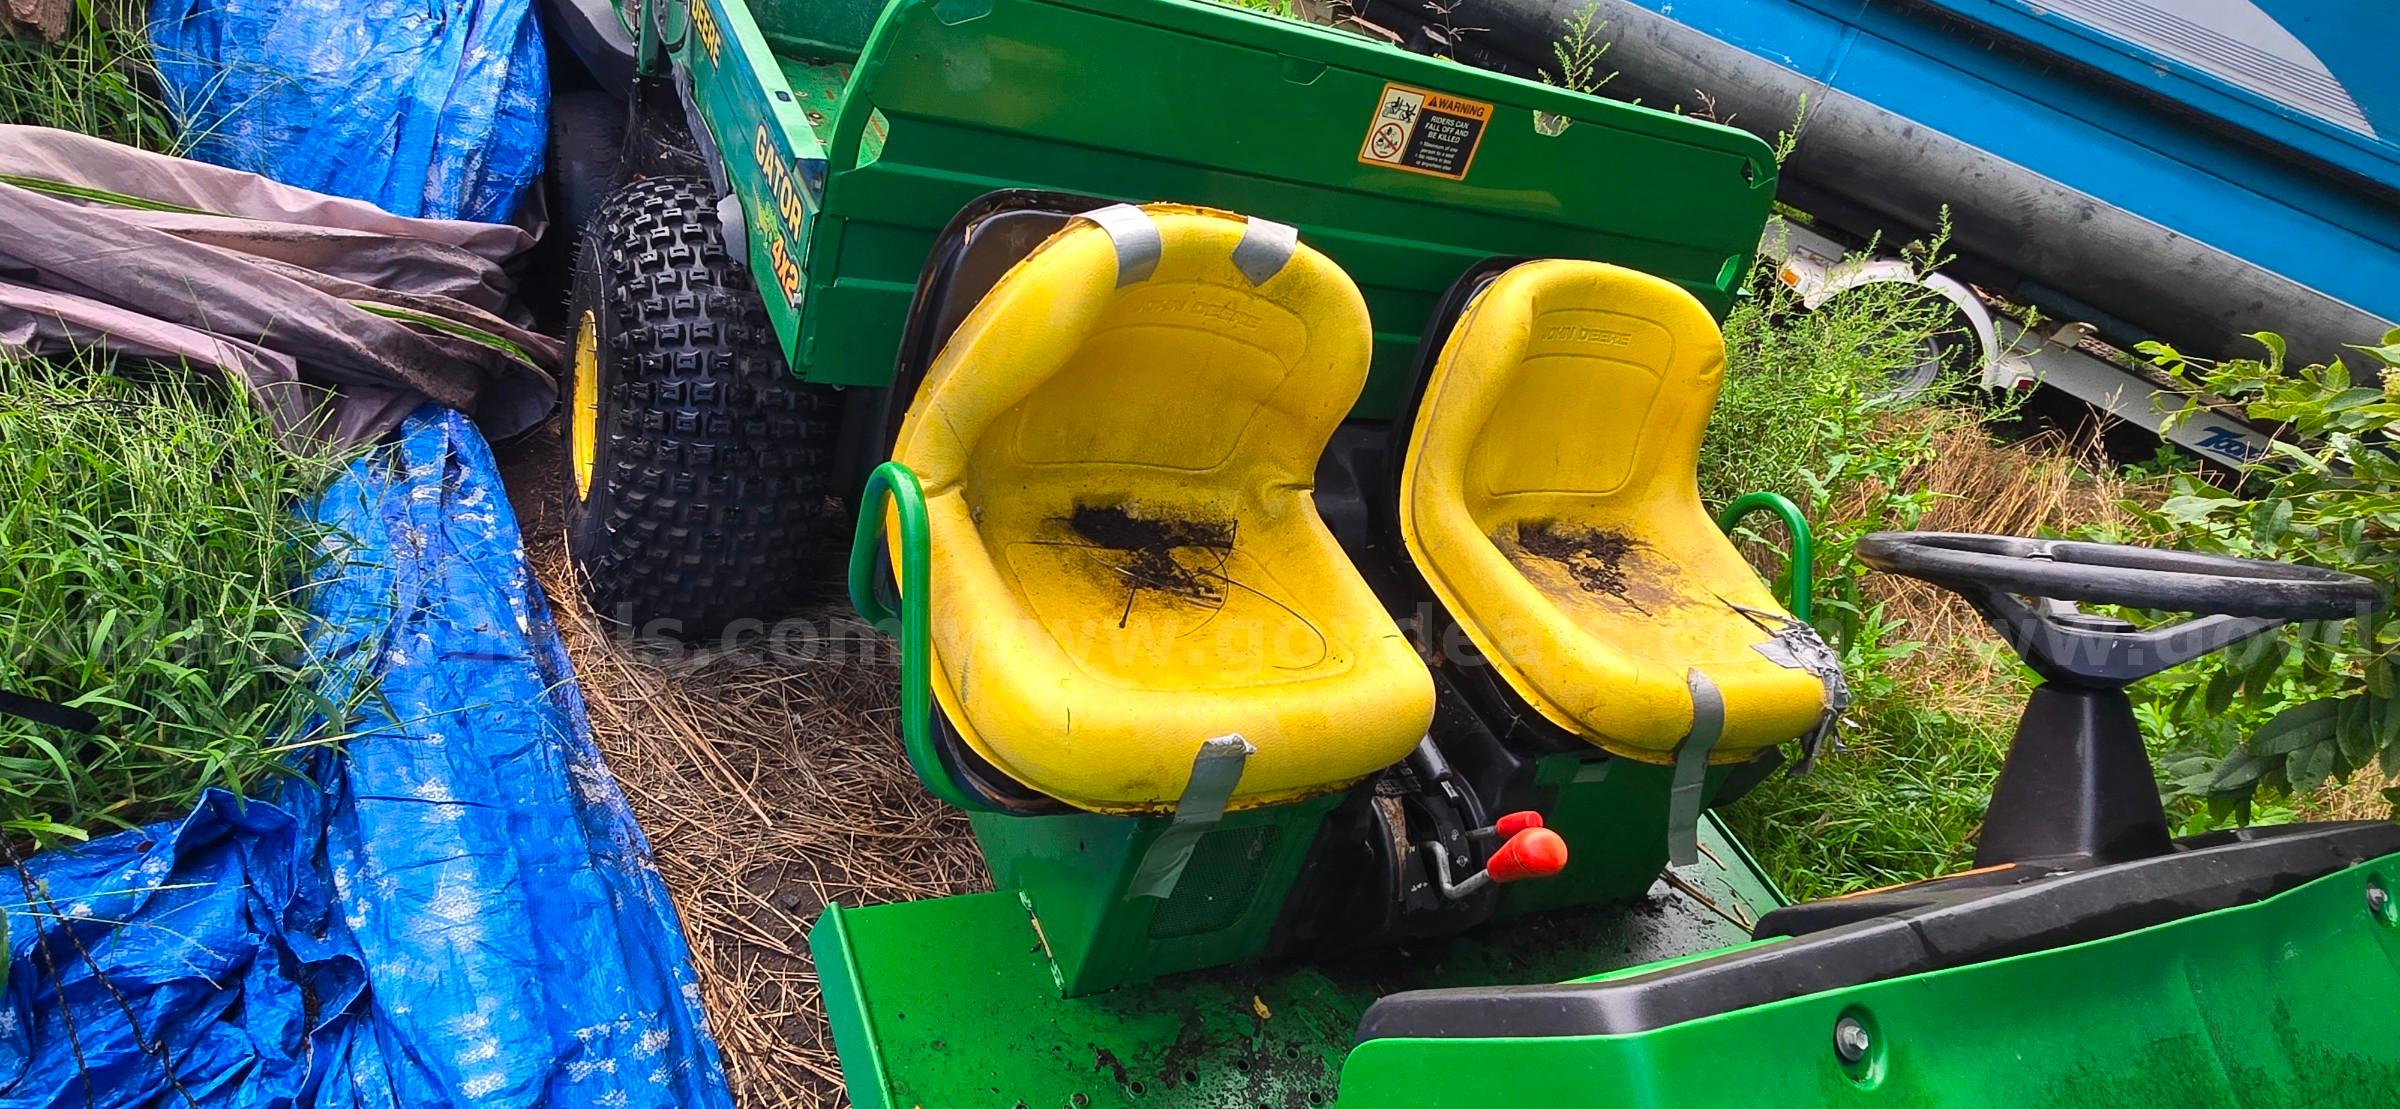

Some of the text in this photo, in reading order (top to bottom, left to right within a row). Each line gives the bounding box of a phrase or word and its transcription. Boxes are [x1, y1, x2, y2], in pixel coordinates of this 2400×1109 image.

[1438, 98, 1485, 117] WARNING
[1424, 122, 1469, 137] FALL OFF AND
[1430, 115, 1470, 129] RIDERS CAN
[1427, 131, 1461, 144] BE KILLED
[755, 124, 803, 243] GATOR
[1191, 300, 1263, 331] DEERE
[1541, 325, 1633, 348] JOHN DEERE
